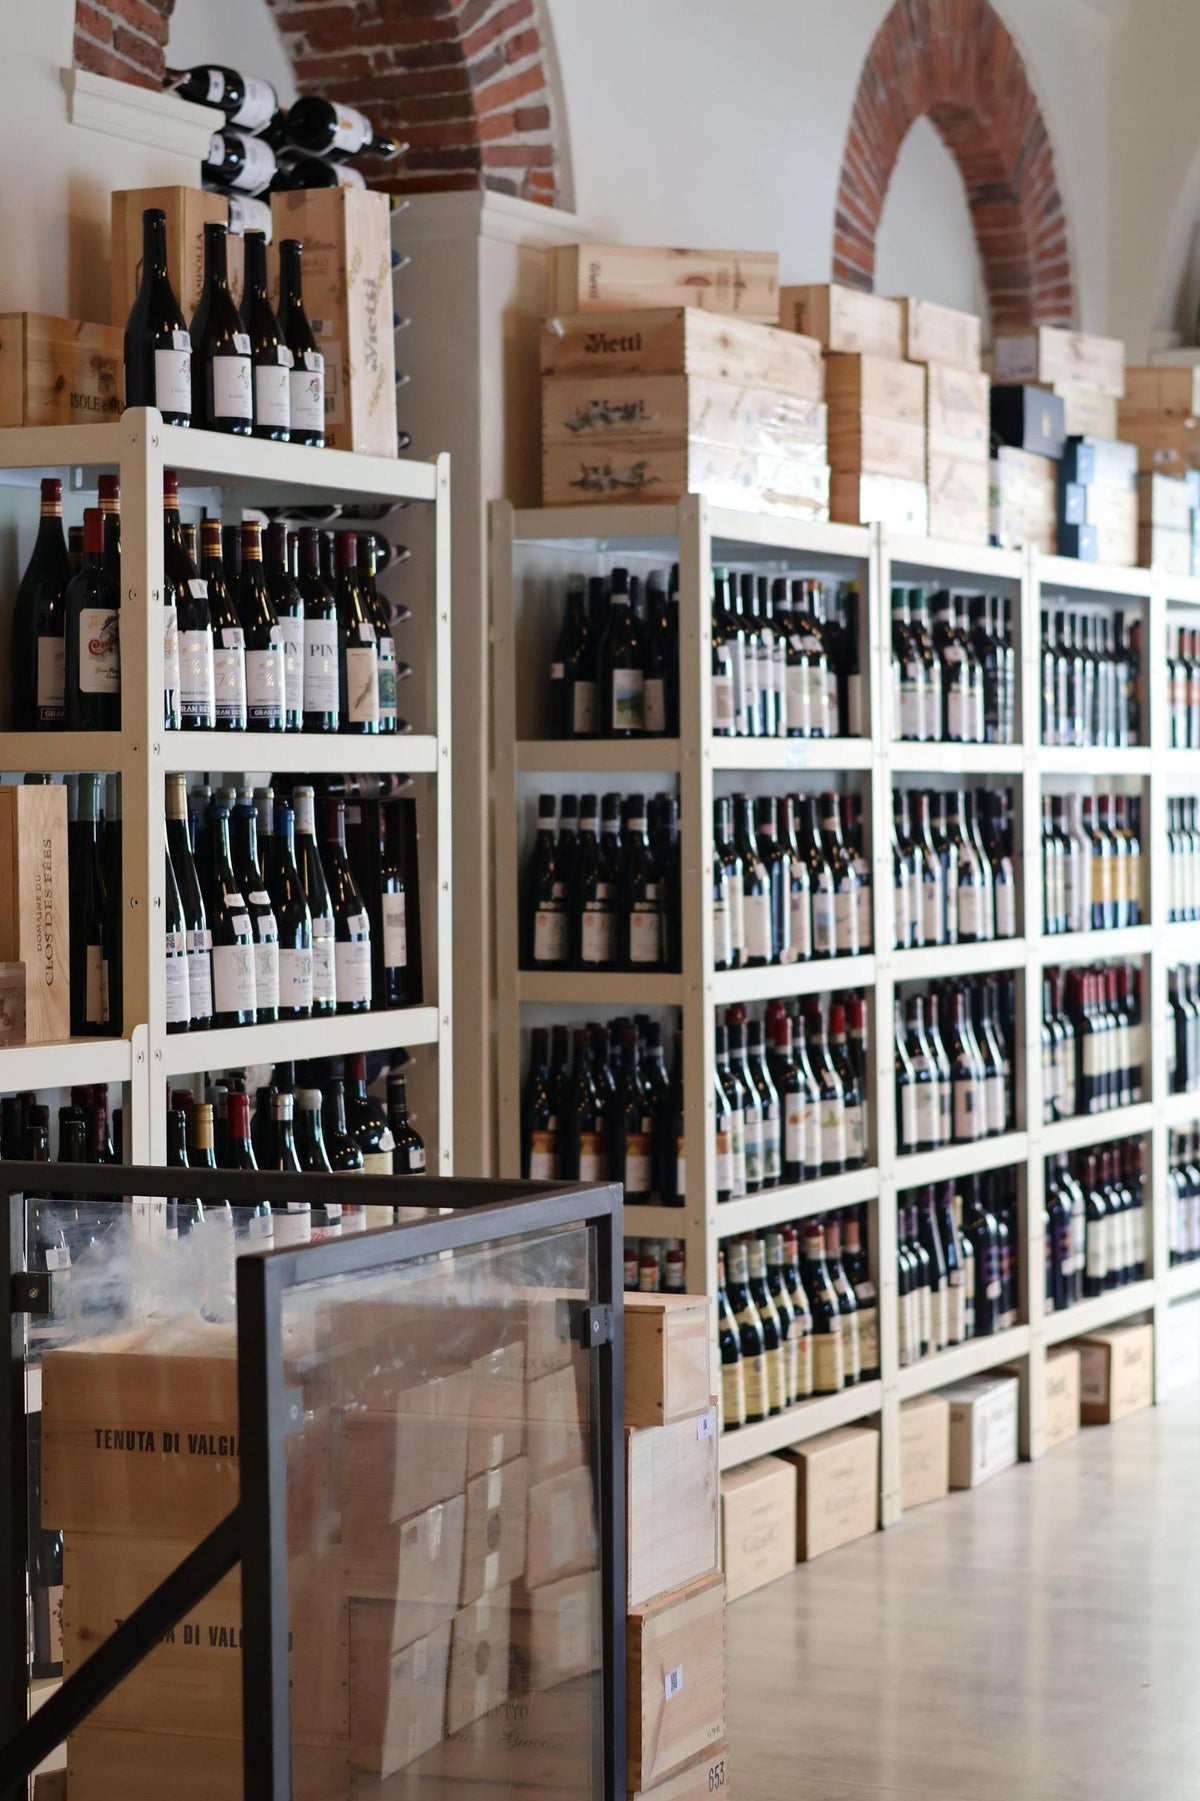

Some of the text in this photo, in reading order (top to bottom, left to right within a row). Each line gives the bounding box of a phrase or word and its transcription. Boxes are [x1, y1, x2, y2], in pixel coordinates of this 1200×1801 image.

[584, 332, 642, 354] Vietti
[69, 393, 100, 411] ISOLE
[35, 874, 41, 892] DU
[44, 892, 53, 929] DES
[44, 933, 54, 986] CLOS
[94, 1428, 155, 1452] TENUTA
[163, 1433, 180, 1453] DI
[183, 1625, 200, 1646] DI
[708, 1760, 725, 1793] 653
